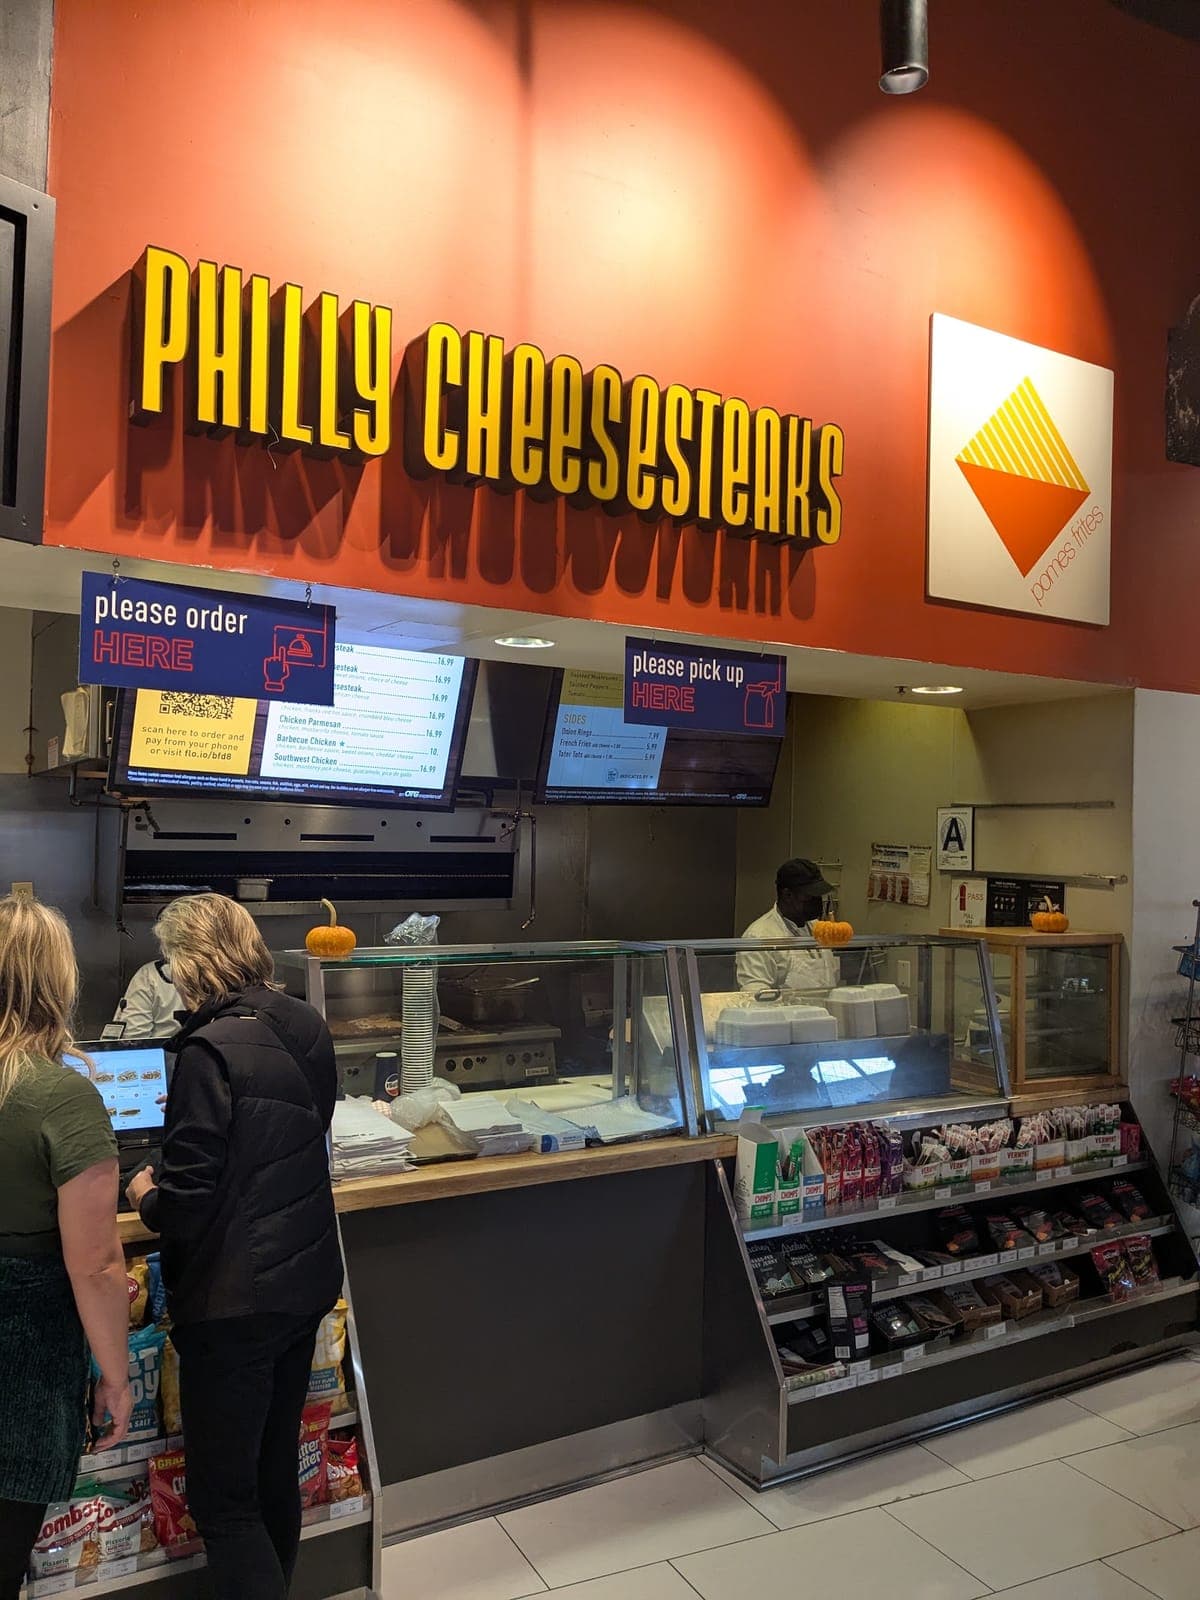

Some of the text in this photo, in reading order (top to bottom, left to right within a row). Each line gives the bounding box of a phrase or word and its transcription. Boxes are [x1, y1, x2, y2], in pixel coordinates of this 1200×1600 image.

[141, 244, 392, 457] PHILLY
[1030, 504, 1104, 607] pomes frites
[95, 590, 248, 634] please order
[94, 629, 194, 672] HERE
[438, 657, 454, 666] 16.99
[633, 650, 744, 688] please pick up
[435, 675, 451, 684] 16.99
[432, 693, 449, 703] 16.99
[632, 681, 695, 713] HERE
[429, 711, 445, 720] 16.99
[563, 713, 587, 724] SIDES
[280, 714, 442, 738] Chicken Parmesan 16.99
[142, 725, 245, 742] scan here to order and
[276, 733, 309, 744] Barbecue
[310, 737, 337, 747] Chicken
[146, 736, 238, 752] pay from your phone
[560, 738, 578, 747] French
[578, 740, 592, 748] Fries
[163, 747, 182, 757] visit
[184, 750, 232, 761] flo.io/bfd8
[559, 750, 571, 759] Tater
[572, 751, 583, 759] Tots
[274, 752, 436, 774] Southwest Chicken 16.99
[942, 817, 965, 851] A
[968, 892, 985, 901] PASS
[781, 1189, 799, 1199] CHOMPS
[805, 1185, 822, 1195] CHOMPS
[754, 1192, 772, 1204] CHOMPS
